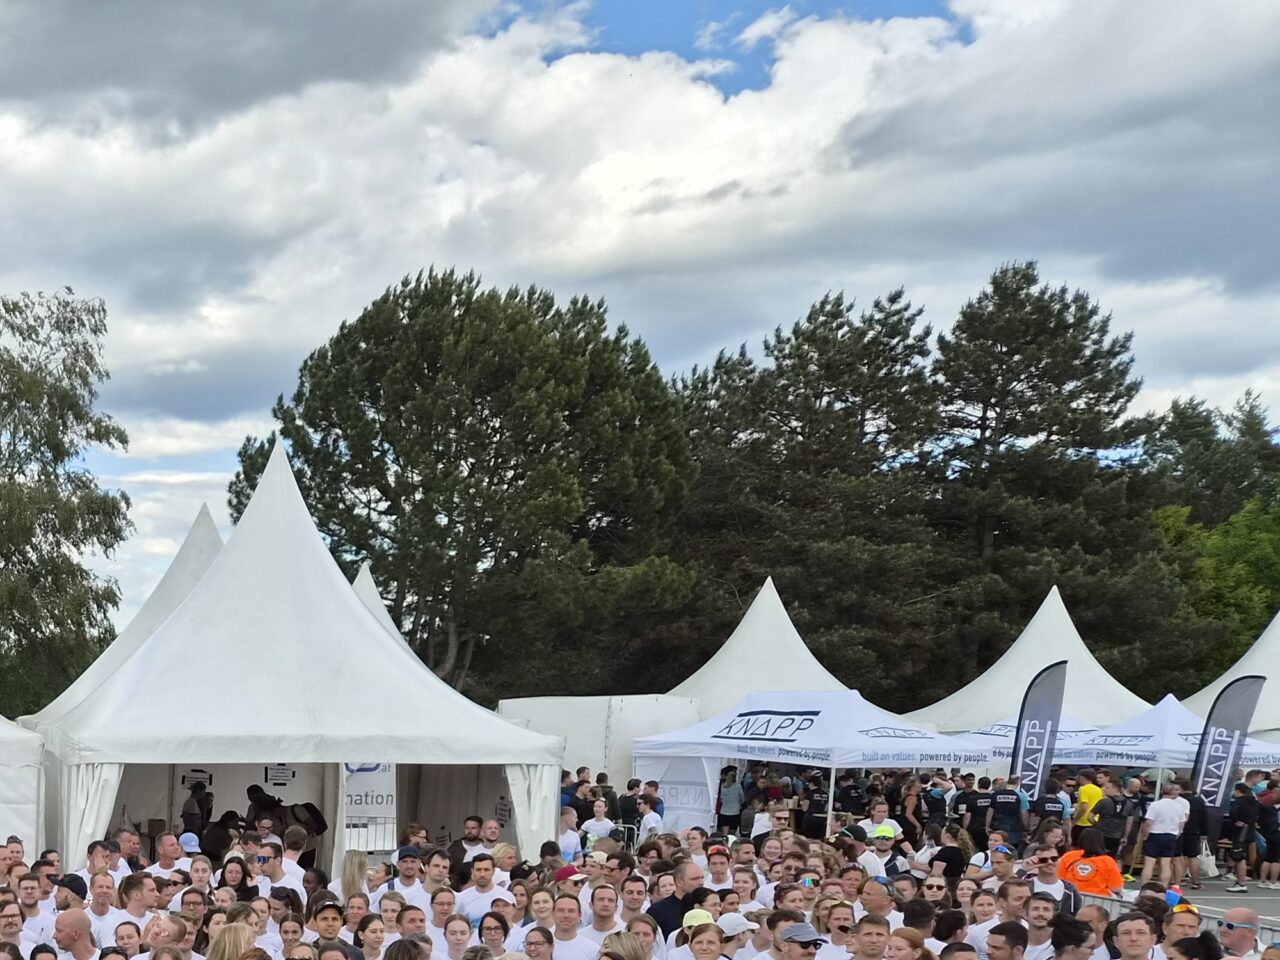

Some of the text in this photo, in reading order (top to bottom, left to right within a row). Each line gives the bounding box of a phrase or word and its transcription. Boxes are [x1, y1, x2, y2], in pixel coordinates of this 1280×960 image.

[718, 717, 815, 737] KNAPP
[778, 747, 803, 758] powered
[862, 752, 878, 761] built
[920, 752, 952, 764] powered
[953, 752, 962, 765] by
[1020, 719, 1045, 801] KNAPP
[1201, 727, 1233, 807] KNAPP
